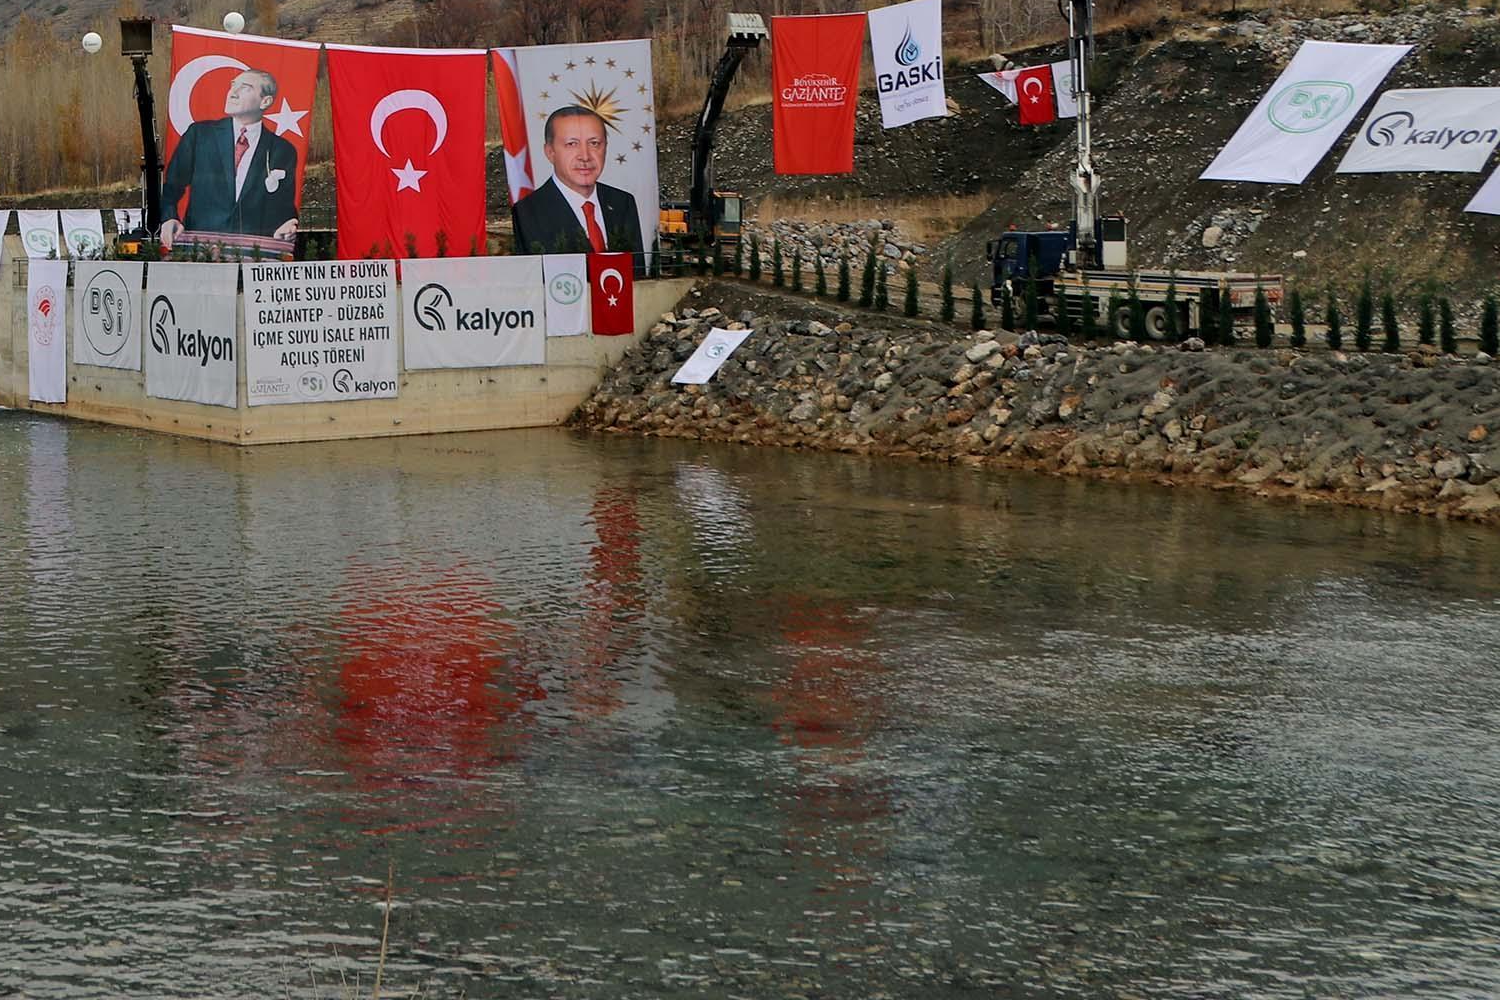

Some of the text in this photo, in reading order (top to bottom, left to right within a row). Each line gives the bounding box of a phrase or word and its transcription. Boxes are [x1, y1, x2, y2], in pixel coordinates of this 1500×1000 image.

[878, 56, 941, 93] GASKİ
[1404, 127, 1498, 149] kalyon
[251, 262, 389, 282] TÜRKİYE'NİN EN BÜYÜK
[254, 281, 387, 305] 2. İÇME SUYU PROJESİ
[258, 306, 324, 325] GAZİANTEP
[337, 303, 385, 321] DÜZBAĞ
[456, 307, 534, 336] kalyon
[177, 328, 233, 367] kalyon
[252, 326, 390, 349] İÇME SUYU İSALE HATTI
[280, 345, 366, 368] AÇILIŞ TÖRENİ
[354, 380, 396, 394] kalyon
